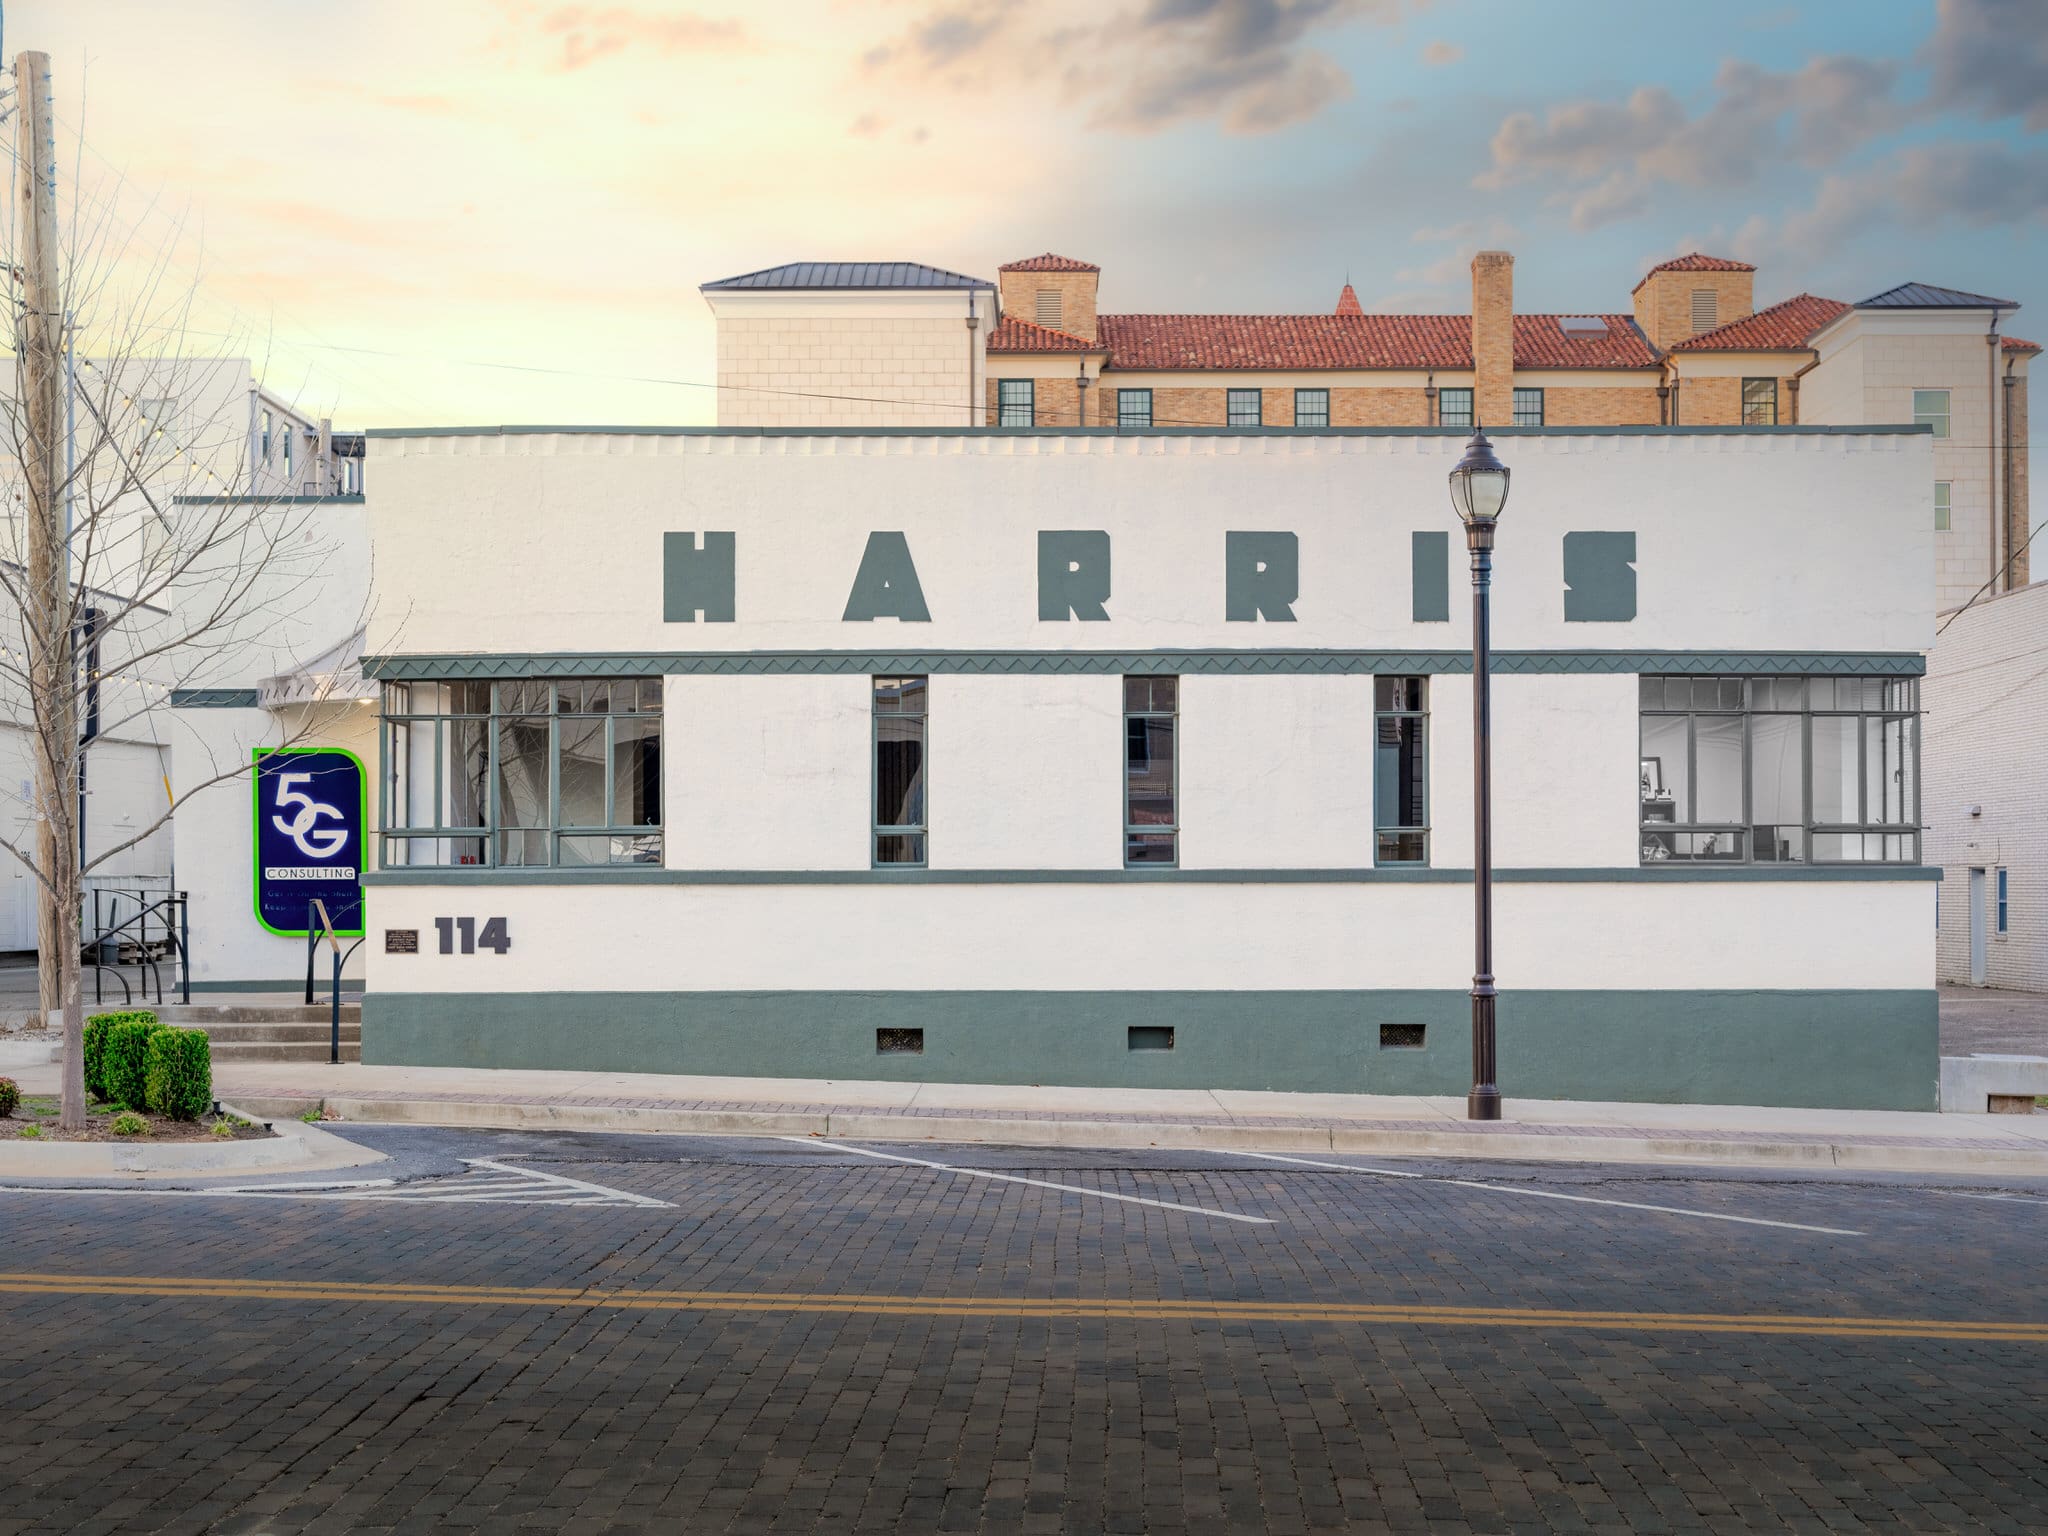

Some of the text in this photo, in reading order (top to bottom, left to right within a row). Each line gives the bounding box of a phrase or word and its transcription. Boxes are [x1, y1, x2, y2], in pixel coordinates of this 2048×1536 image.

[664, 530, 1637, 622] HARRIS
[272, 773, 349, 858] 5G
[266, 868, 354, 879] CONSULTING
[434, 917, 512, 954] 114
